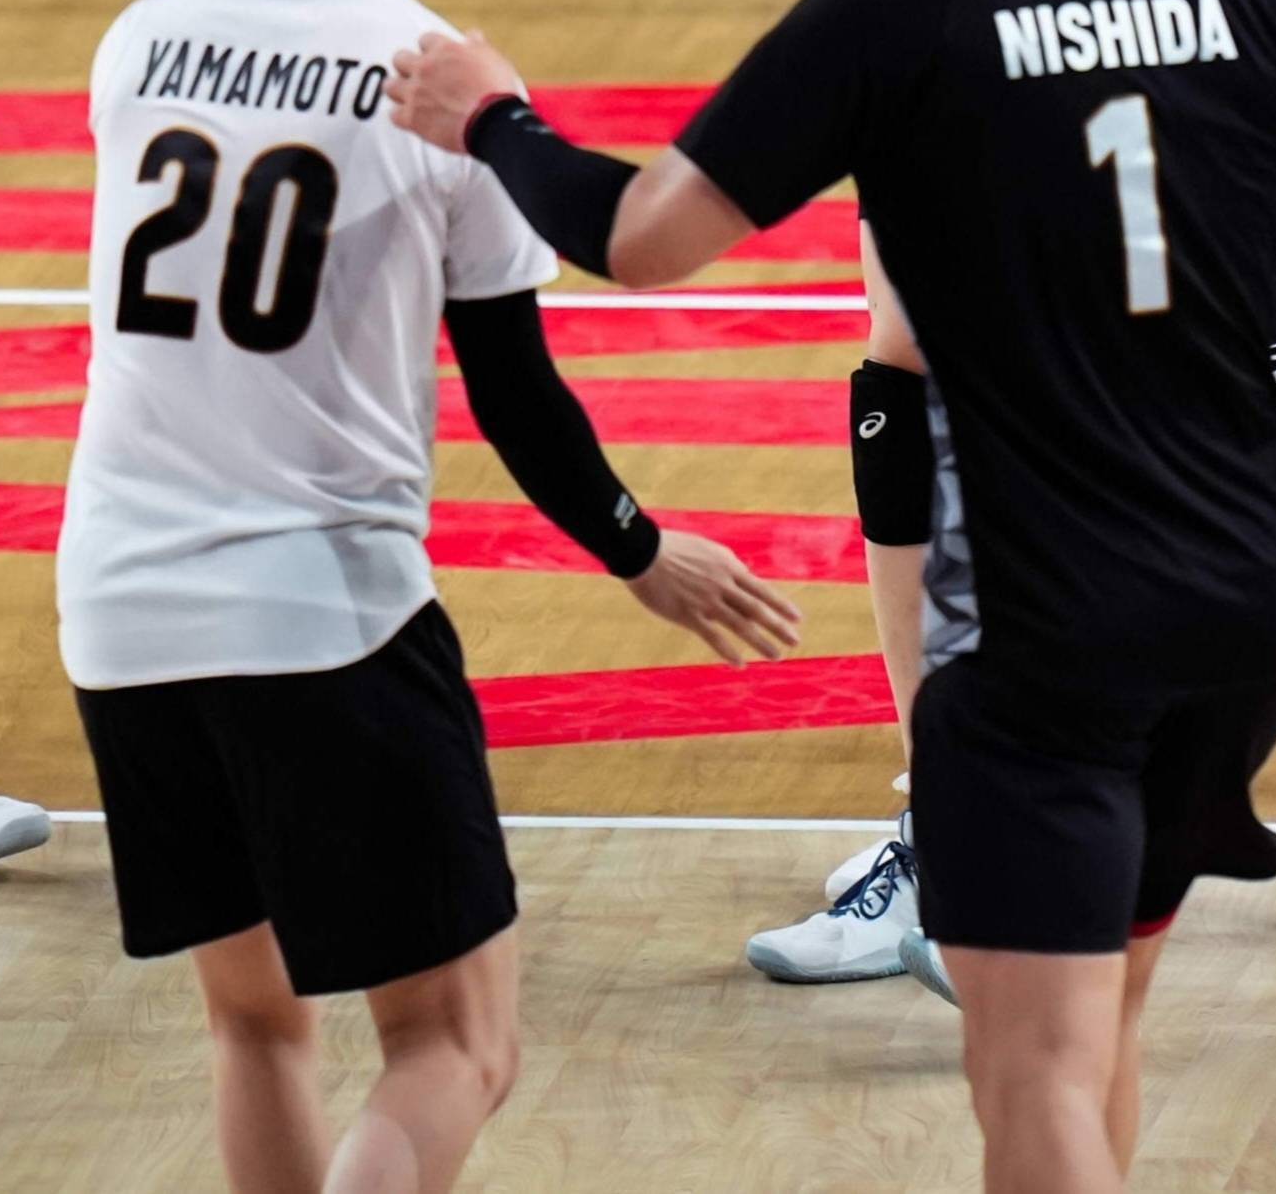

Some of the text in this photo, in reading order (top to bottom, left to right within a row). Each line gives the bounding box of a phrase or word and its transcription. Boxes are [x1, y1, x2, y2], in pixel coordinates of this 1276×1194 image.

[136, 39, 390, 122] YAMAMOTO
[115, 126, 340, 355] 20
[1083, 93, 1172, 317] 1
